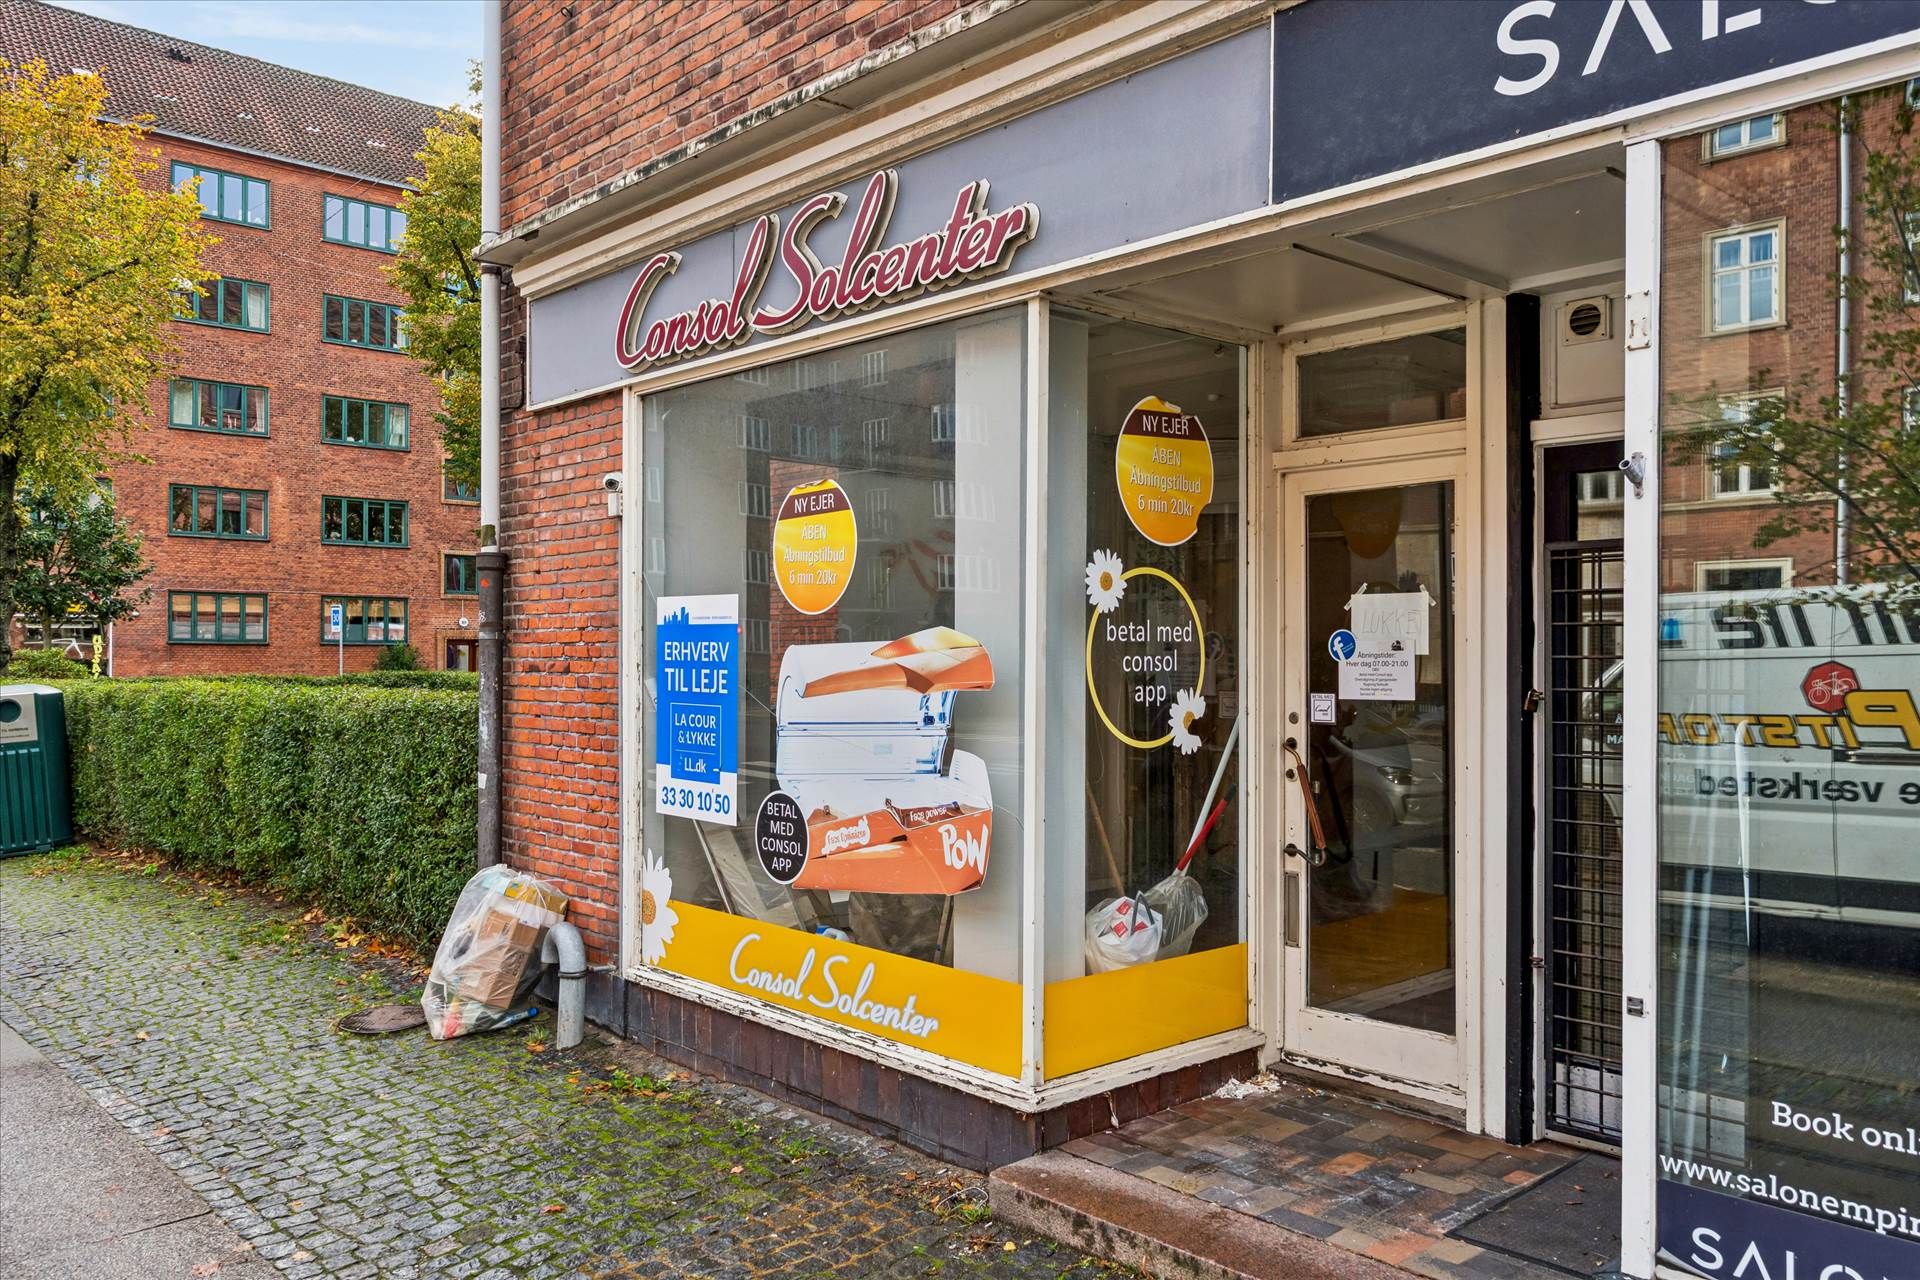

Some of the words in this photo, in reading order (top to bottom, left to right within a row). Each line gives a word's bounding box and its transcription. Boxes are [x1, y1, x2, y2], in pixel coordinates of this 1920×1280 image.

[615, 213, 773, 370] Consol
[750, 169, 1034, 331] Solcenter
[1142, 415, 1158, 432] NY
[1162, 416, 1189, 435] EJER
[794, 496, 808, 514] NY
[811, 493, 835, 512] EJER
[1138, 495, 1145, 510] 6
[1148, 496, 1168, 513] min
[1171, 498, 1194, 517] 20kr
[789, 569, 795, 584] 6
[797, 571, 815, 585] min
[816, 569, 838, 585] 20kr
[1106, 618, 1151, 642] betal
[1157, 620, 1192, 642] med
[664, 641, 730, 662] ERHVERV
[1122, 649, 1178, 673] consol
[1360, 660, 1372, 668] dag
[664, 668, 688, 692] TIL
[691, 668, 728, 694] LEJE
[1135, 684, 1166, 707] app
[674, 713, 687, 726] LA
[688, 714, 716, 728] COUR
[678, 730, 685, 744] &
[686, 731, 716, 747] LYKKE
[684, 757, 706, 773] LL.dk
[662, 786, 676, 806] 33
[679, 788, 694, 808] 30
[697, 791, 712, 812] 10
[714, 793, 731, 815] 50
[767, 802, 798, 819] BETAL
[770, 820, 794, 836] MED
[761, 837, 803, 856] CONSOL
[772, 856, 792, 872] APP
[729, 933, 815, 1000] Consol
[808, 955, 939, 1038] Solcenter
[1771, 1101, 1855, 1142] Book
[1861, 1128, 1920, 1155] onl
